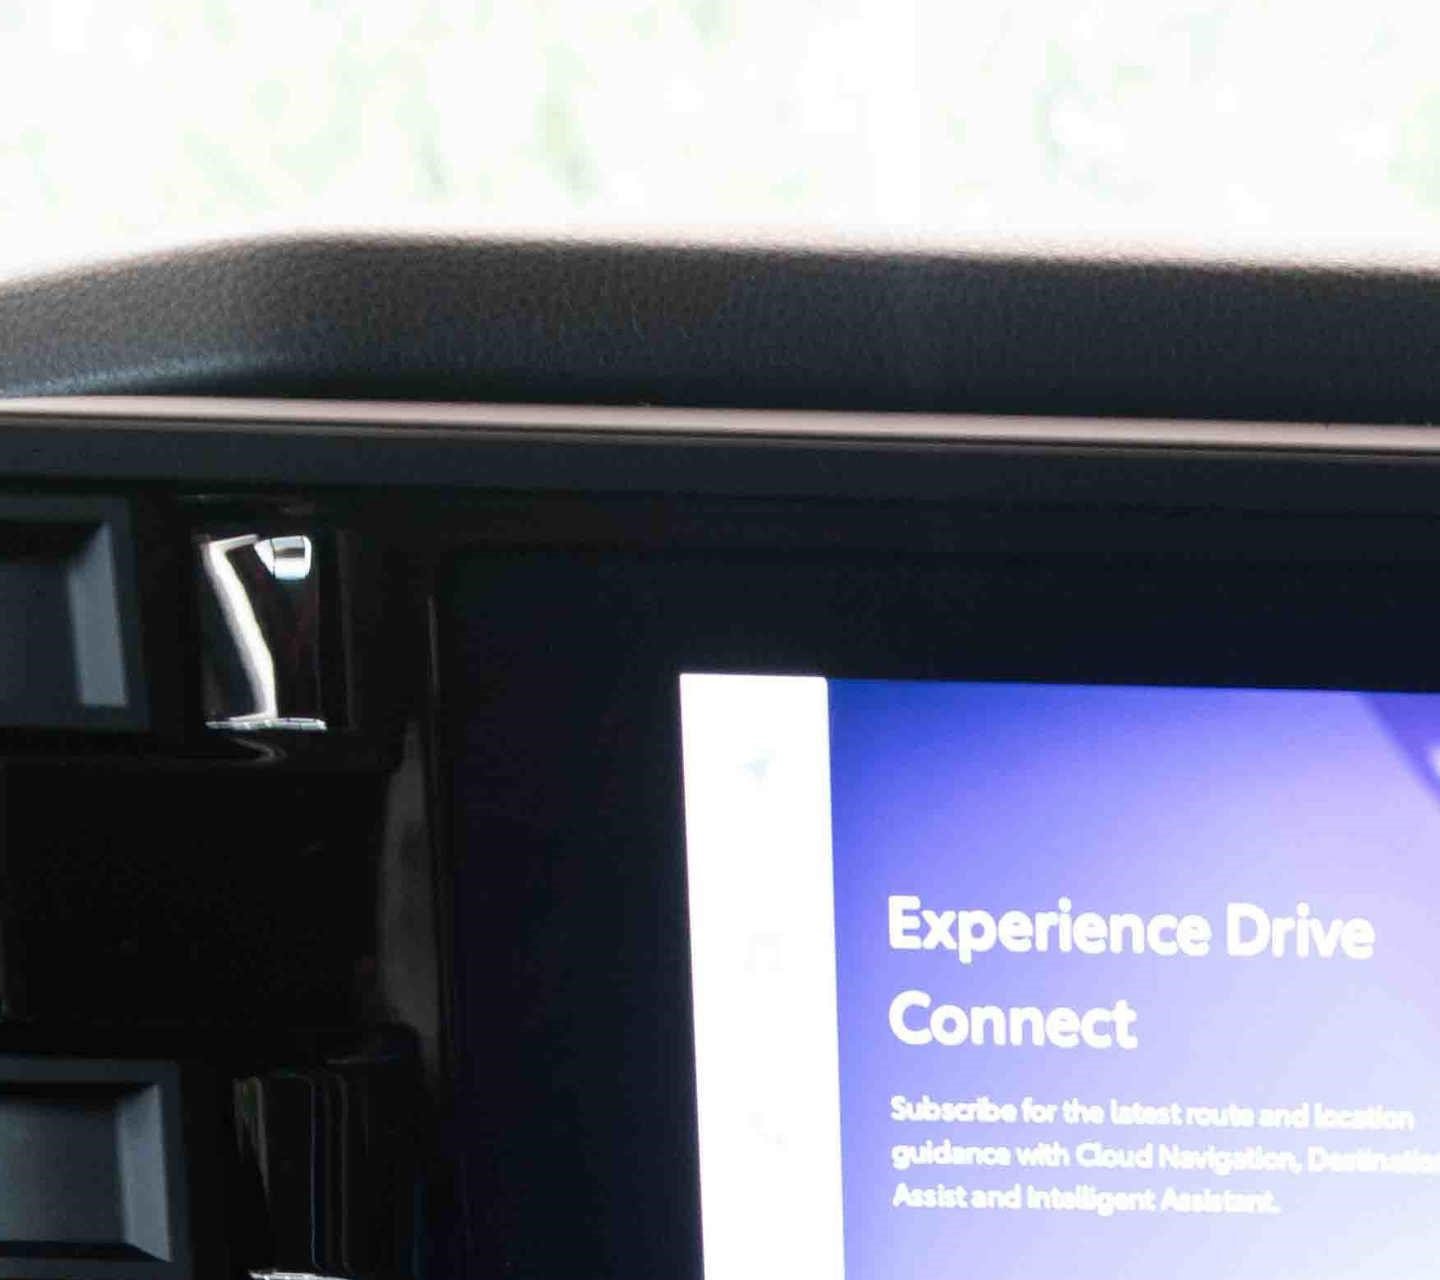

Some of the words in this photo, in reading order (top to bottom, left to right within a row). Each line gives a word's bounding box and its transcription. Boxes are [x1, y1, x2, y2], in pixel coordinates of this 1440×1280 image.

[888, 895, 1212, 963] Experience
[1226, 900, 1375, 959] Drive
[888, 990, 1138, 1049] Connect
[891, 1095, 1017, 1123] Subscribe
[1021, 1097, 1057, 1123] for
[1062, 1098, 1105, 1125] the
[1110, 1099, 1182, 1126] latest
[1186, 1104, 1254, 1128] route
[1260, 1103, 1308, 1129] and
[1314, 1102, 1415, 1131] location
[892, 1139, 1011, 1170] guidance
[1016, 1141, 1070, 1167] with
[1075, 1141, 1153, 1169] Cloud
[1158, 1143, 1302, 1176] Navigation,
[892, 1182, 968, 1209] Assist
[970, 1183, 1022, 1209] and
[1027, 1184, 1157, 1217] Intelligent
[1161, 1187, 1281, 1215] Assistant.
